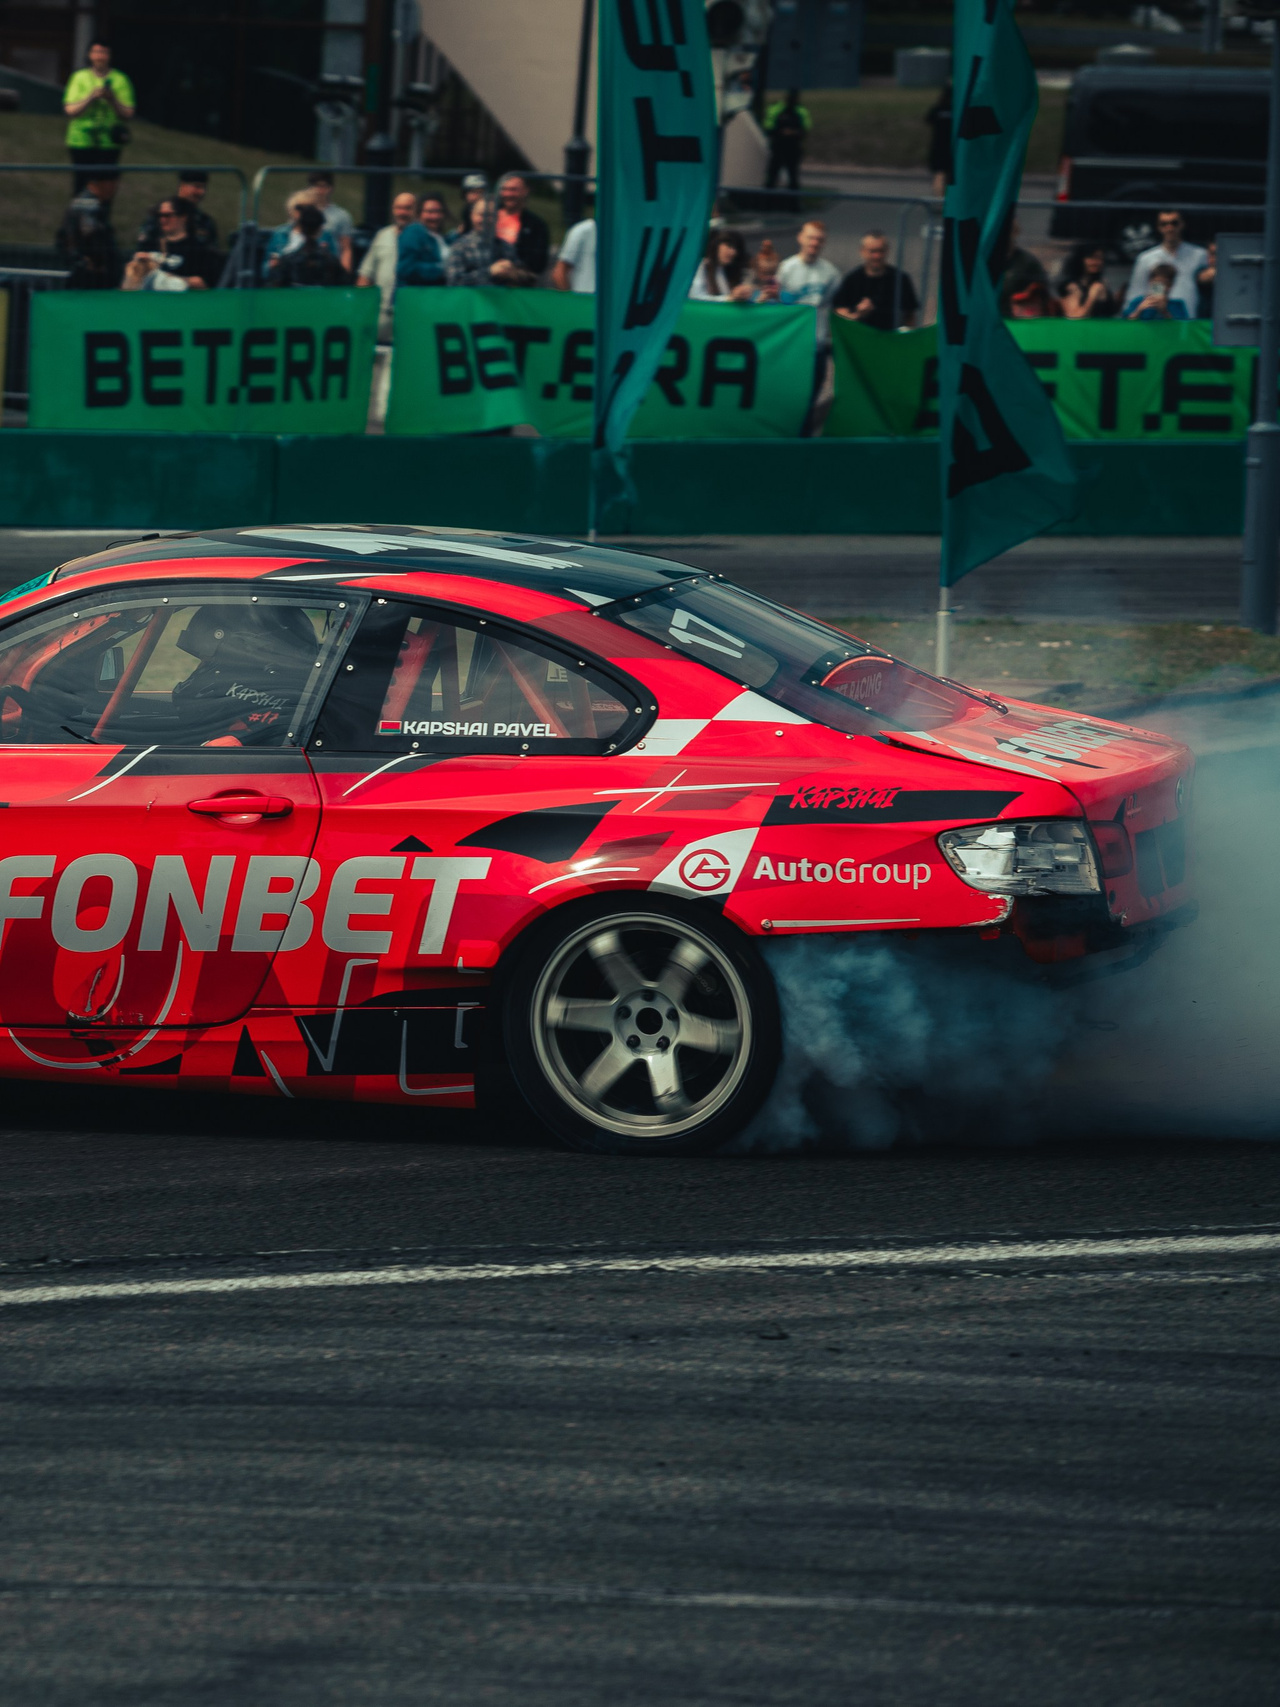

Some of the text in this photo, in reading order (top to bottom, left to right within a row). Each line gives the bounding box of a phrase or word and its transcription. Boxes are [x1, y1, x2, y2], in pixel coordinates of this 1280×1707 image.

[83, 325, 352, 409] BET.ERA
[668, 608, 746, 659] 17
[403, 721, 558, 737] KAPSHAI PAVEL
[753, 856, 931, 889] AutoGroup
